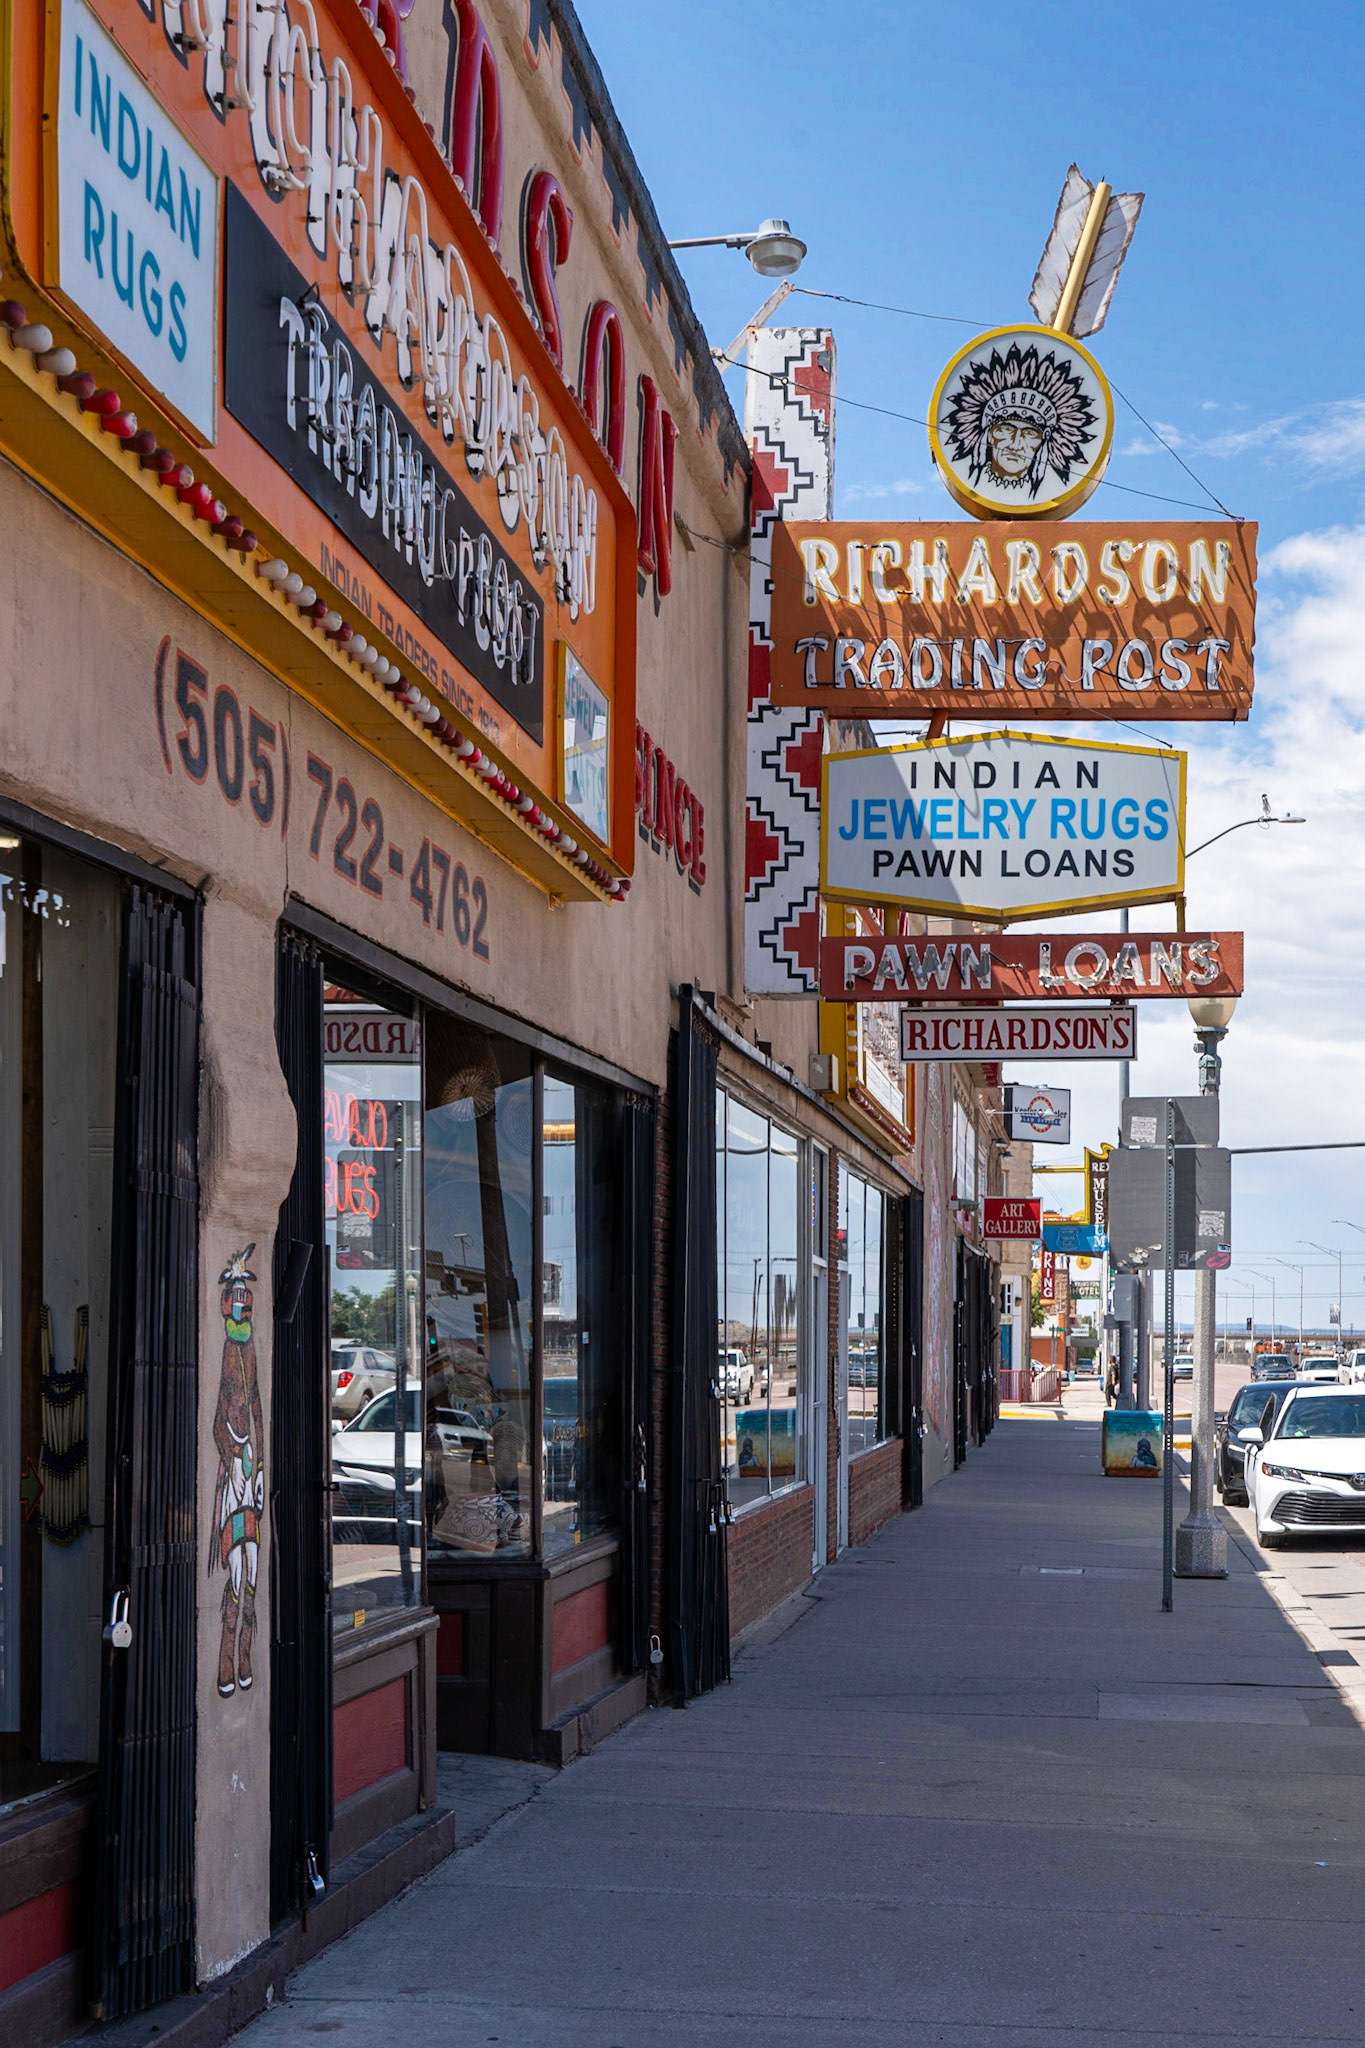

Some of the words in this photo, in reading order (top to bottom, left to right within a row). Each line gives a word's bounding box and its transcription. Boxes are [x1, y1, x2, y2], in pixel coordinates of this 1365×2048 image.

[75, 35, 200, 259] INDIAN
[84, 179, 188, 362] RUGS
[279, 296, 456, 586] TRADING
[798, 537, 1232, 608] RICHARDSON
[321, 541, 372, 619] INDIAN
[377, 605, 438, 685] TRADERS
[441, 669, 473, 720] SINCE
[795, 636, 1047, 690] TRADING
[1082, 637, 1231, 691] POST
[154, 634, 292, 843] (505)
[306, 750, 490, 965] 722-4762
[910, 761, 1100, 789] INDIAN
[839, 798, 1046, 841] JEWELRY
[1051, 797, 1169, 841] RUGS
[873, 849, 983, 878] PAWN
[1001, 849, 1135, 878] LOANS
[844, 943, 992, 991] PAWN
[1038, 939, 1221, 989] LOANS
[907, 1016, 1132, 1051] RICHARDSON'S
[985, 1219, 1039, 1234] GALLERY
[1000, 1203, 1025, 1218] ART
[1092, 1178, 1106, 1248] MUSEUM
[1072, 1286, 1100, 1296] HOTEL
